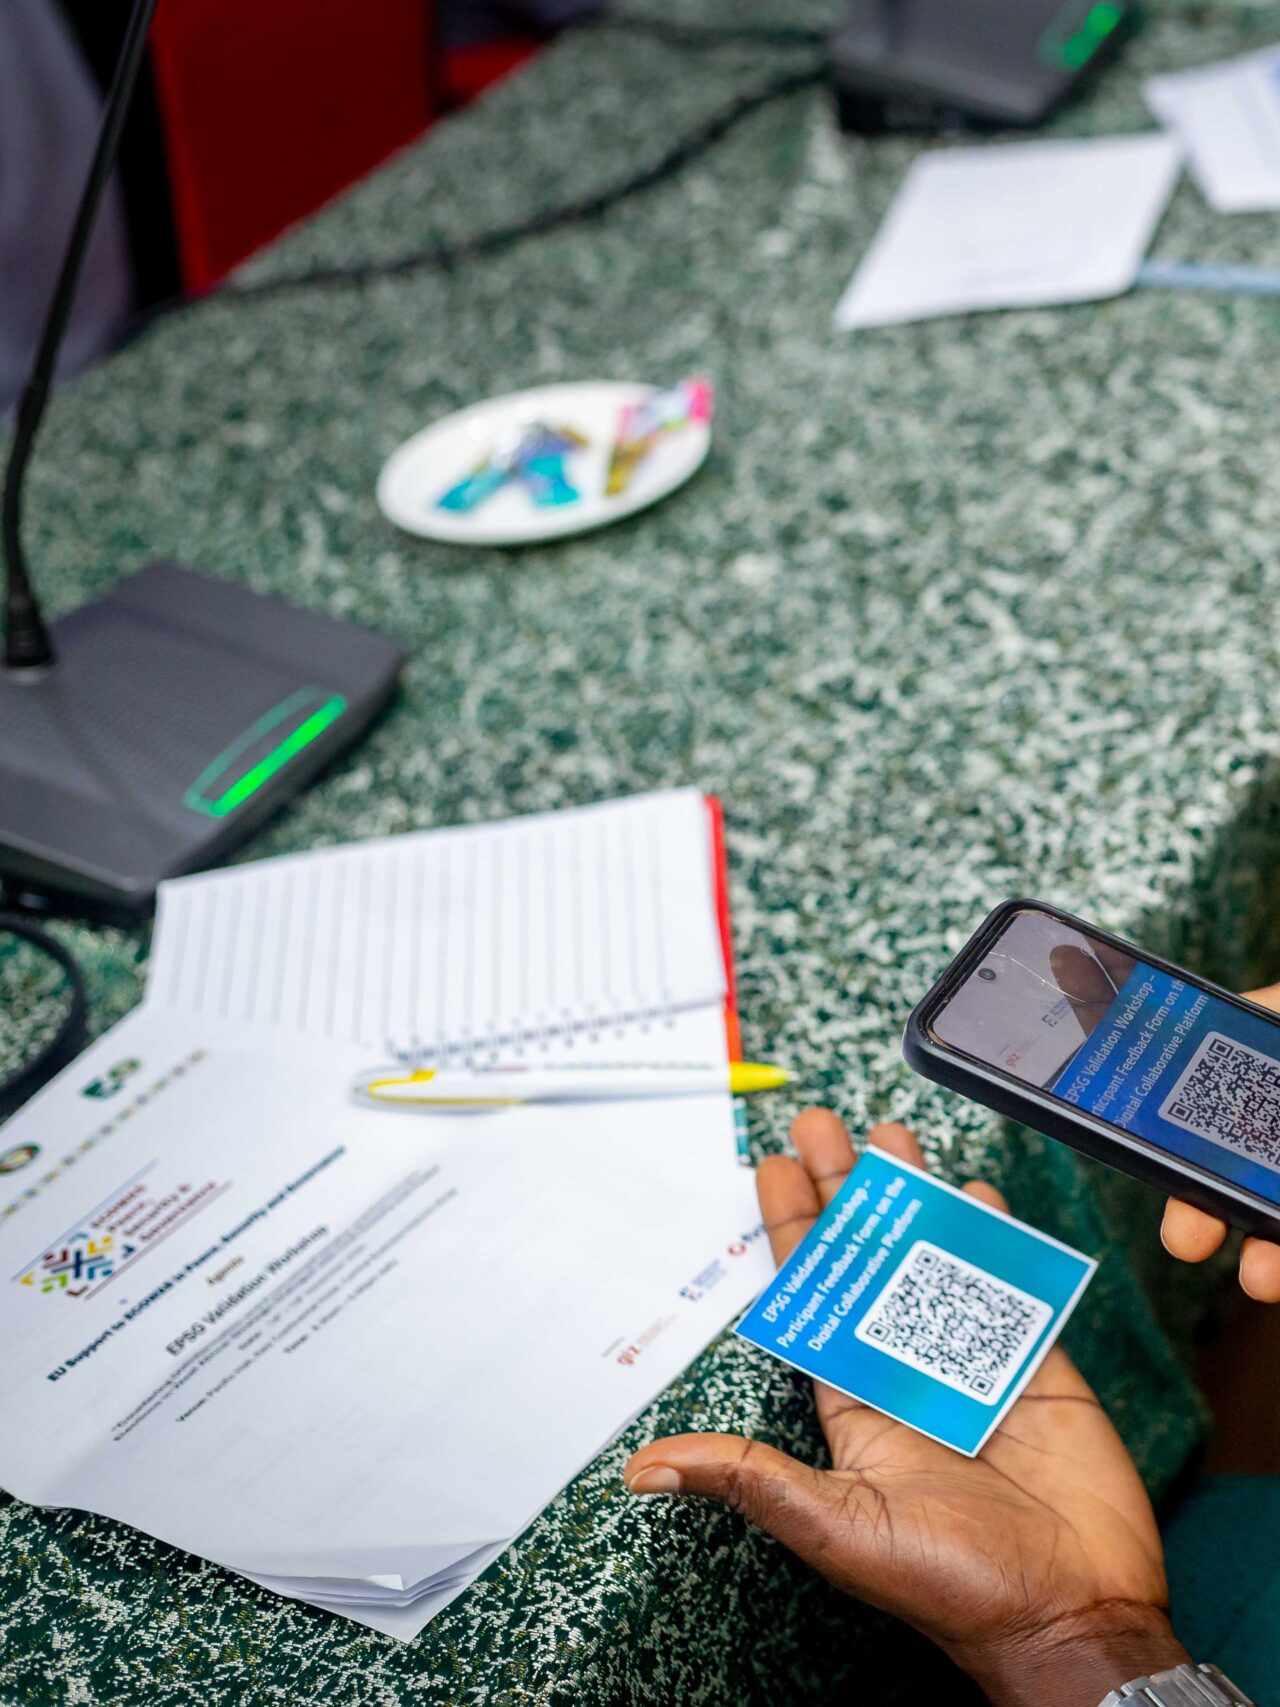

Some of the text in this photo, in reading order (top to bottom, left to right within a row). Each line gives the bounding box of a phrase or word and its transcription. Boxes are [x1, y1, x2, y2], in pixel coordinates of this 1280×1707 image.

[1064, 1076, 1090, 1103] EPSG
[1082, 1030, 1122, 1075] Validation
[1113, 982, 1154, 1029] Workshop
[1092, 978, 1186, 1116] rticipant Feedback Form on th
[1135, 1036, 1182, 1096] Collaborative
[1174, 995, 1208, 1036] Platform
[164, 1320, 208, 1358] EPSG
[200, 1270, 270, 1326] Validation
[762, 1293, 790, 1322] EPSG
[783, 1243, 828, 1293] Validation
[821, 1188, 868, 1242] Workshop
[776, 1177, 906, 1347] Participant Feedback Form on the
[808, 1200, 922, 1351] Digital Collaborative Platform
[46, 1364, 68, 1383] EU
[64, 1328, 114, 1370] Support
